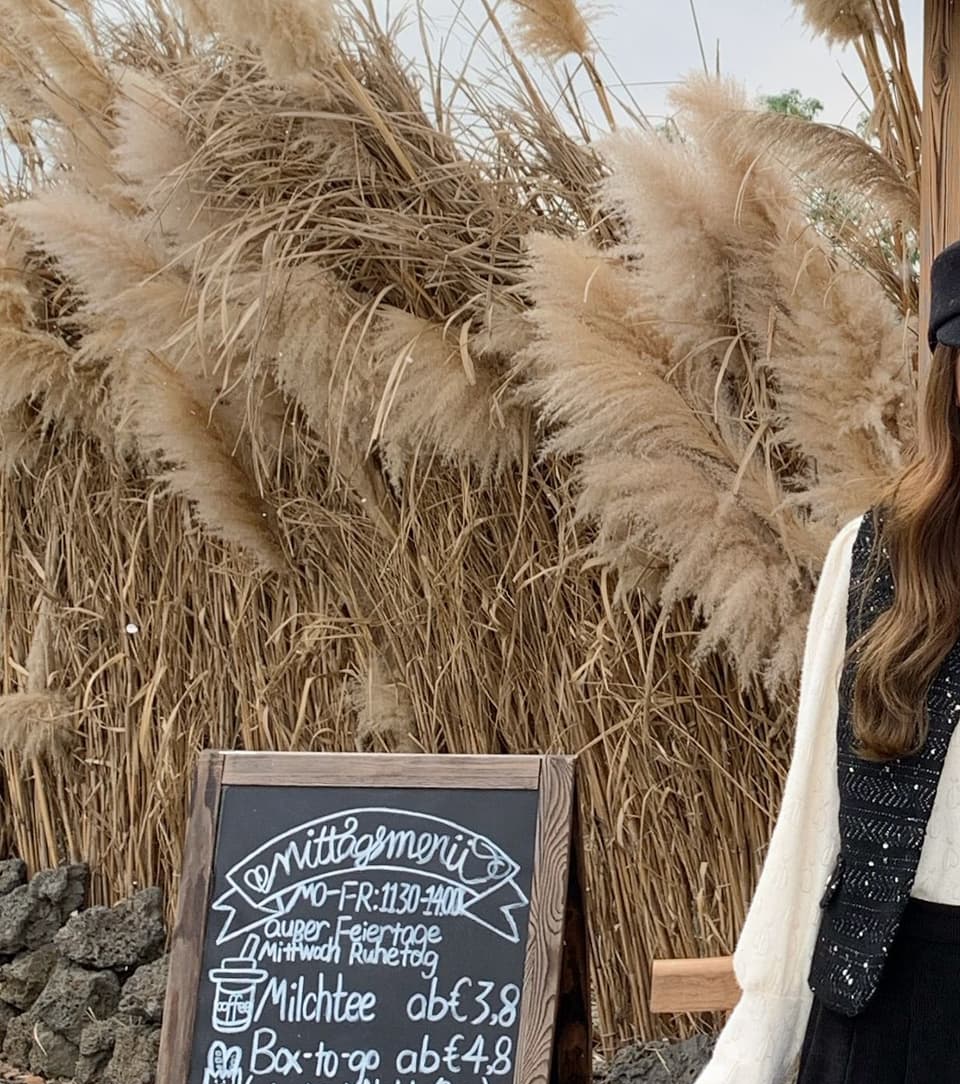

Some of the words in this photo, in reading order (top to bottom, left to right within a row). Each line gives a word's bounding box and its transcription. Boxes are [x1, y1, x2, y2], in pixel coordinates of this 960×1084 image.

[336, 915, 443, 951] Feiertage
[257, 936, 341, 964] Mittwoch
[349, 940, 439, 980] Ruhetag
[253, 972, 376, 1023] Milchtee
